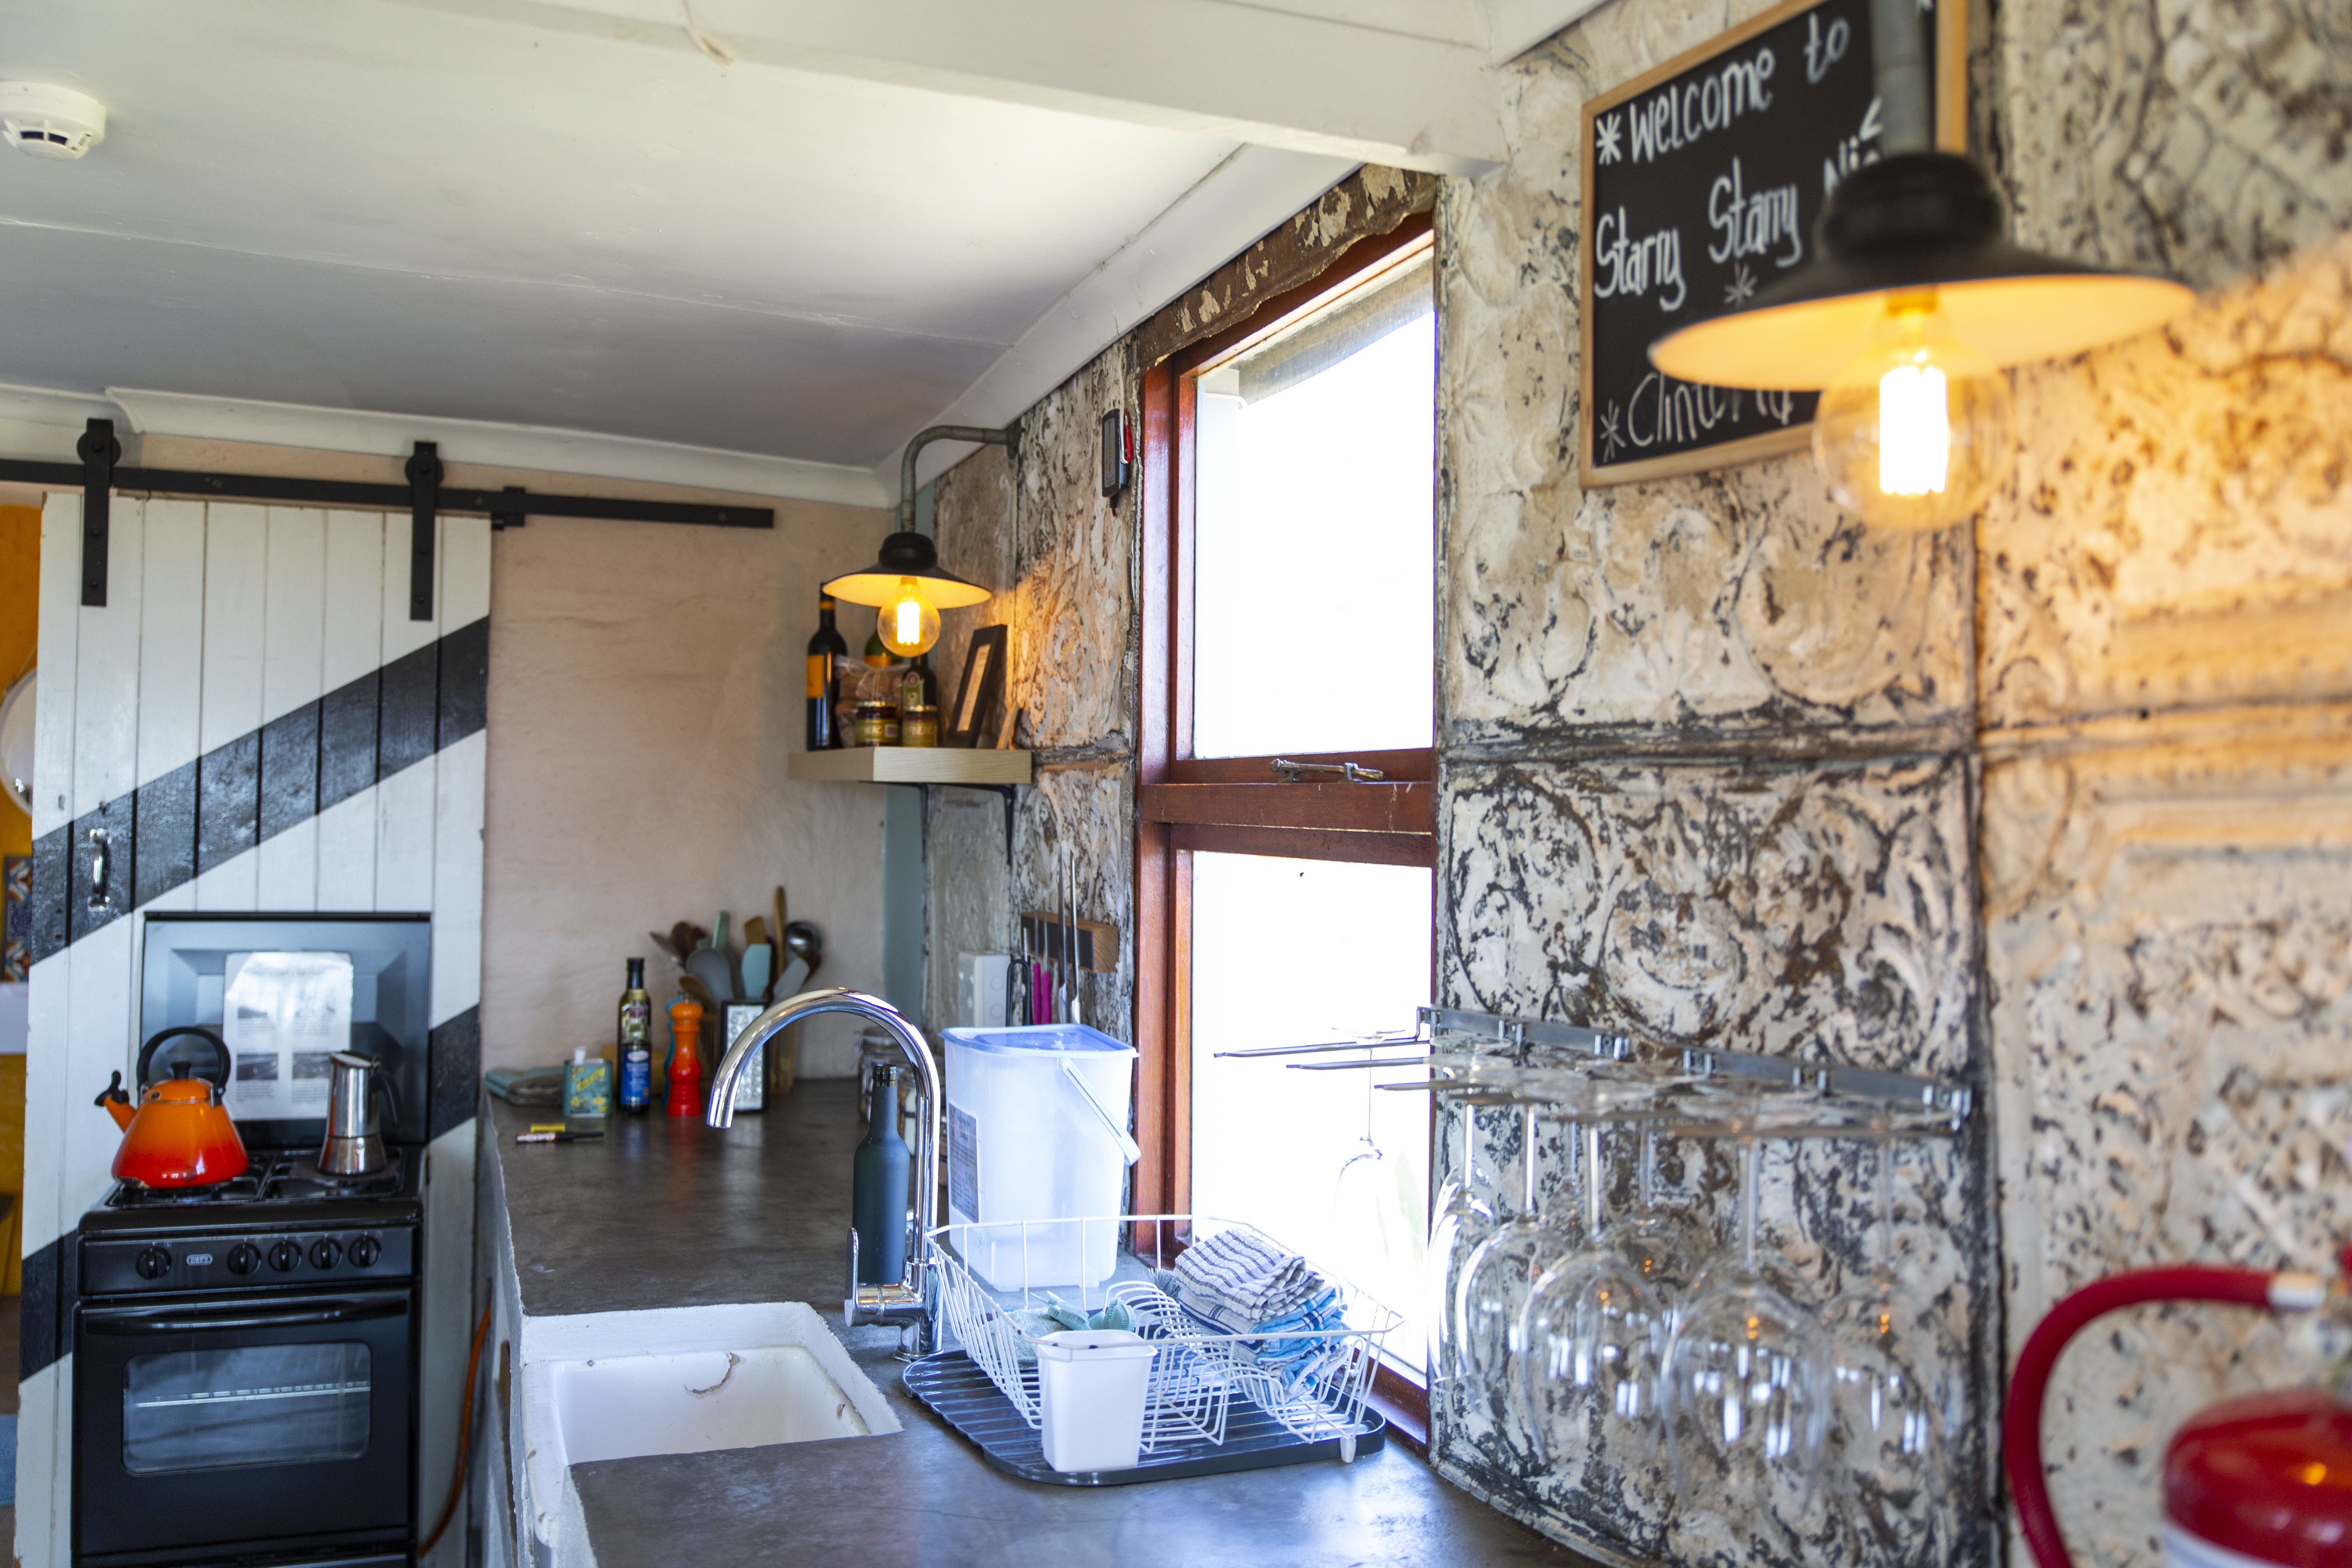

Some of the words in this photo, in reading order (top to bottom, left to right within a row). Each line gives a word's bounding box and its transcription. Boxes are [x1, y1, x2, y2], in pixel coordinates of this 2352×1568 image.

[1629, 47, 1775, 164] Welcome
[1803, 12, 1850, 84] to
[1593, 205, 1687, 313] Starry
[1708, 155, 1803, 268] Starry
